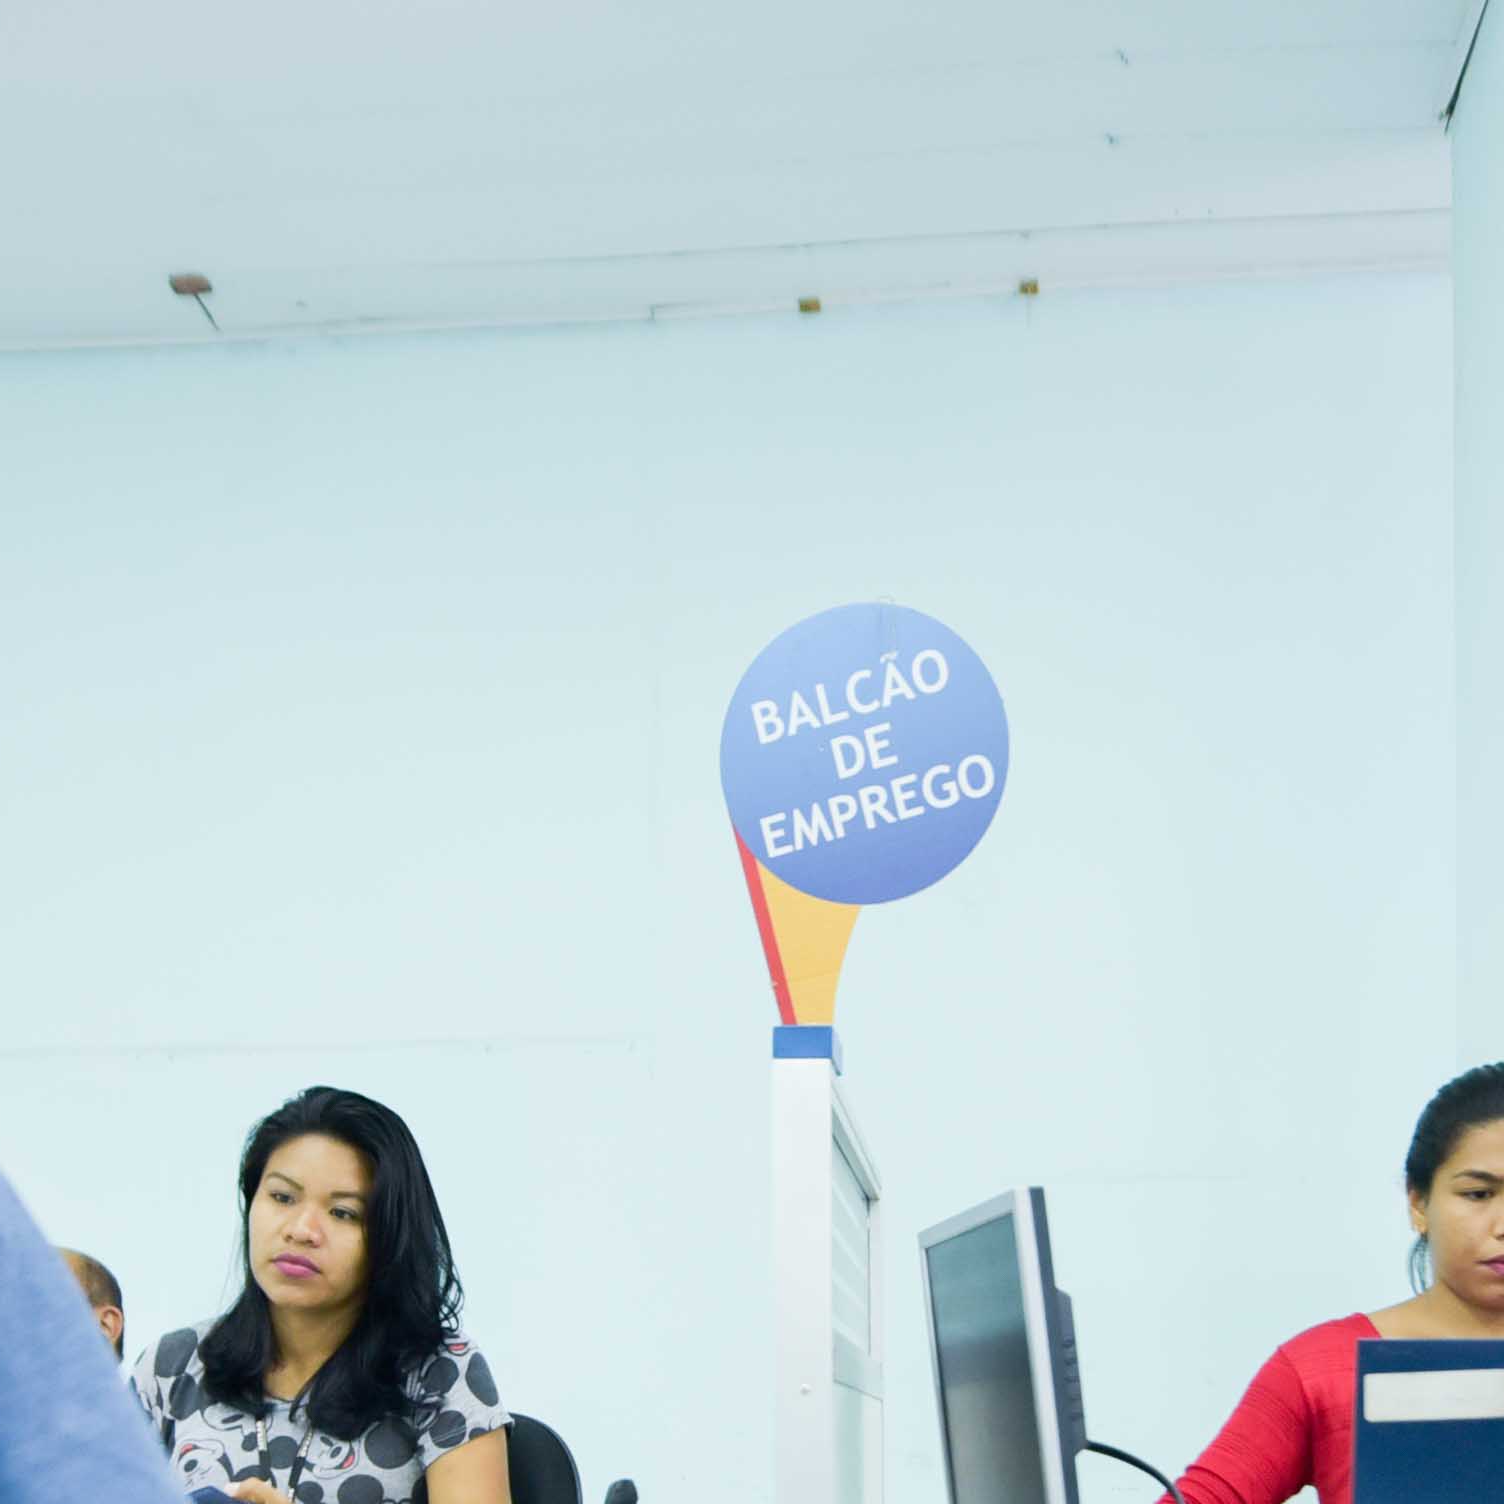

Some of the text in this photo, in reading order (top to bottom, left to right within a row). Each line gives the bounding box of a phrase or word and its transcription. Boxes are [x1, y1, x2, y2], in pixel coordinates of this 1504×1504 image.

[751, 649, 949, 744] BALCÃO
[830, 723, 898, 779] DE
[760, 754, 995, 857] EMPREGO
